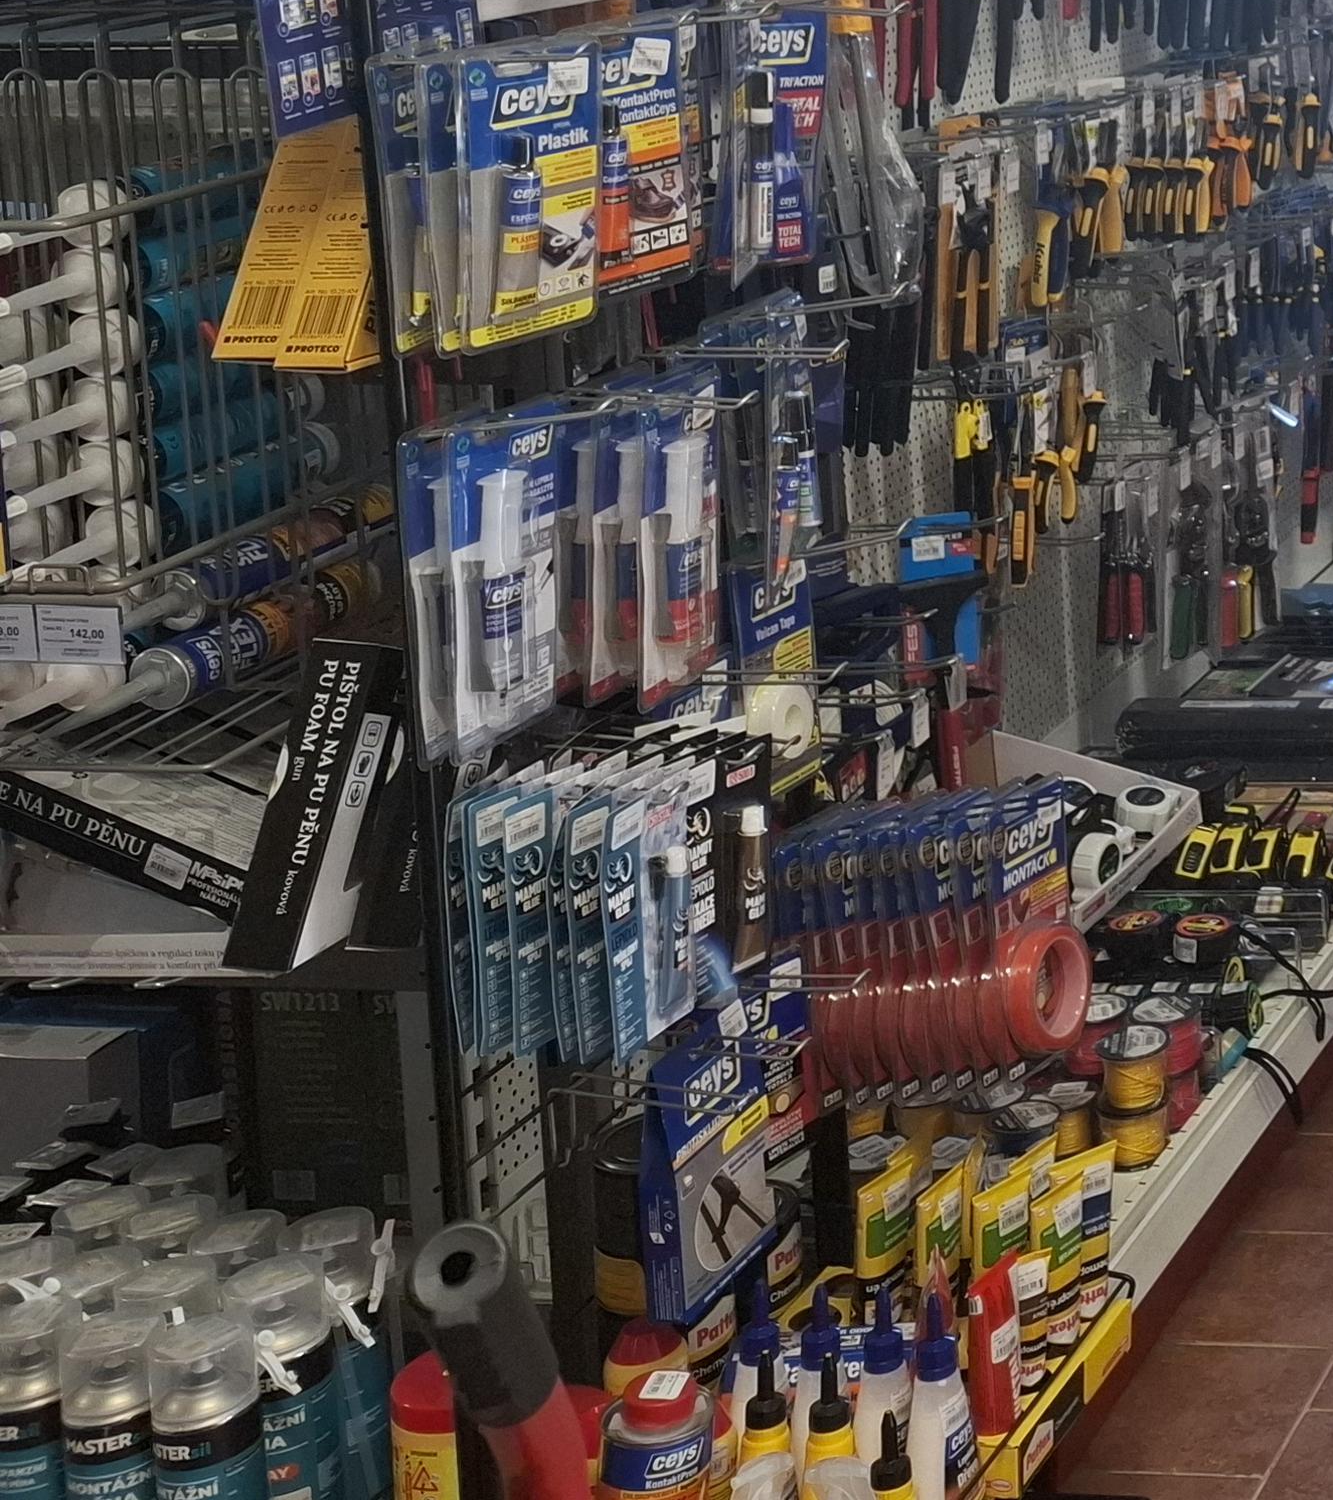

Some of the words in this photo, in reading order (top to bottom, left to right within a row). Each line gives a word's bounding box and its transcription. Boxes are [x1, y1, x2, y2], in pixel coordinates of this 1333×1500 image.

[538, 127, 589, 152] Plastik
[231, 335, 279, 344] PROTECO
[293, 345, 341, 353] PROTECO
[511, 430, 548, 457] ceys
[69, 626, 105, 641] 142,00
[320, 659, 340, 684] PU
[331, 661, 361, 733] PIŠTOL
[301, 688, 329, 752] FOAM
[321, 738, 341, 770] NA
[292, 756, 306, 782] gun
[313, 773, 330, 805] PU
[12, 786, 45, 817] NA
[51, 804, 81, 830] PU
[83, 820, 146, 858] PĚNU
[292, 806, 322, 867] PĚNU
[1003, 853, 1049, 887] MONTACK
[276, 869, 300, 917] kovová
[608, 884, 635, 912] MAMUT
[652, 1441, 700, 1470] ceys
